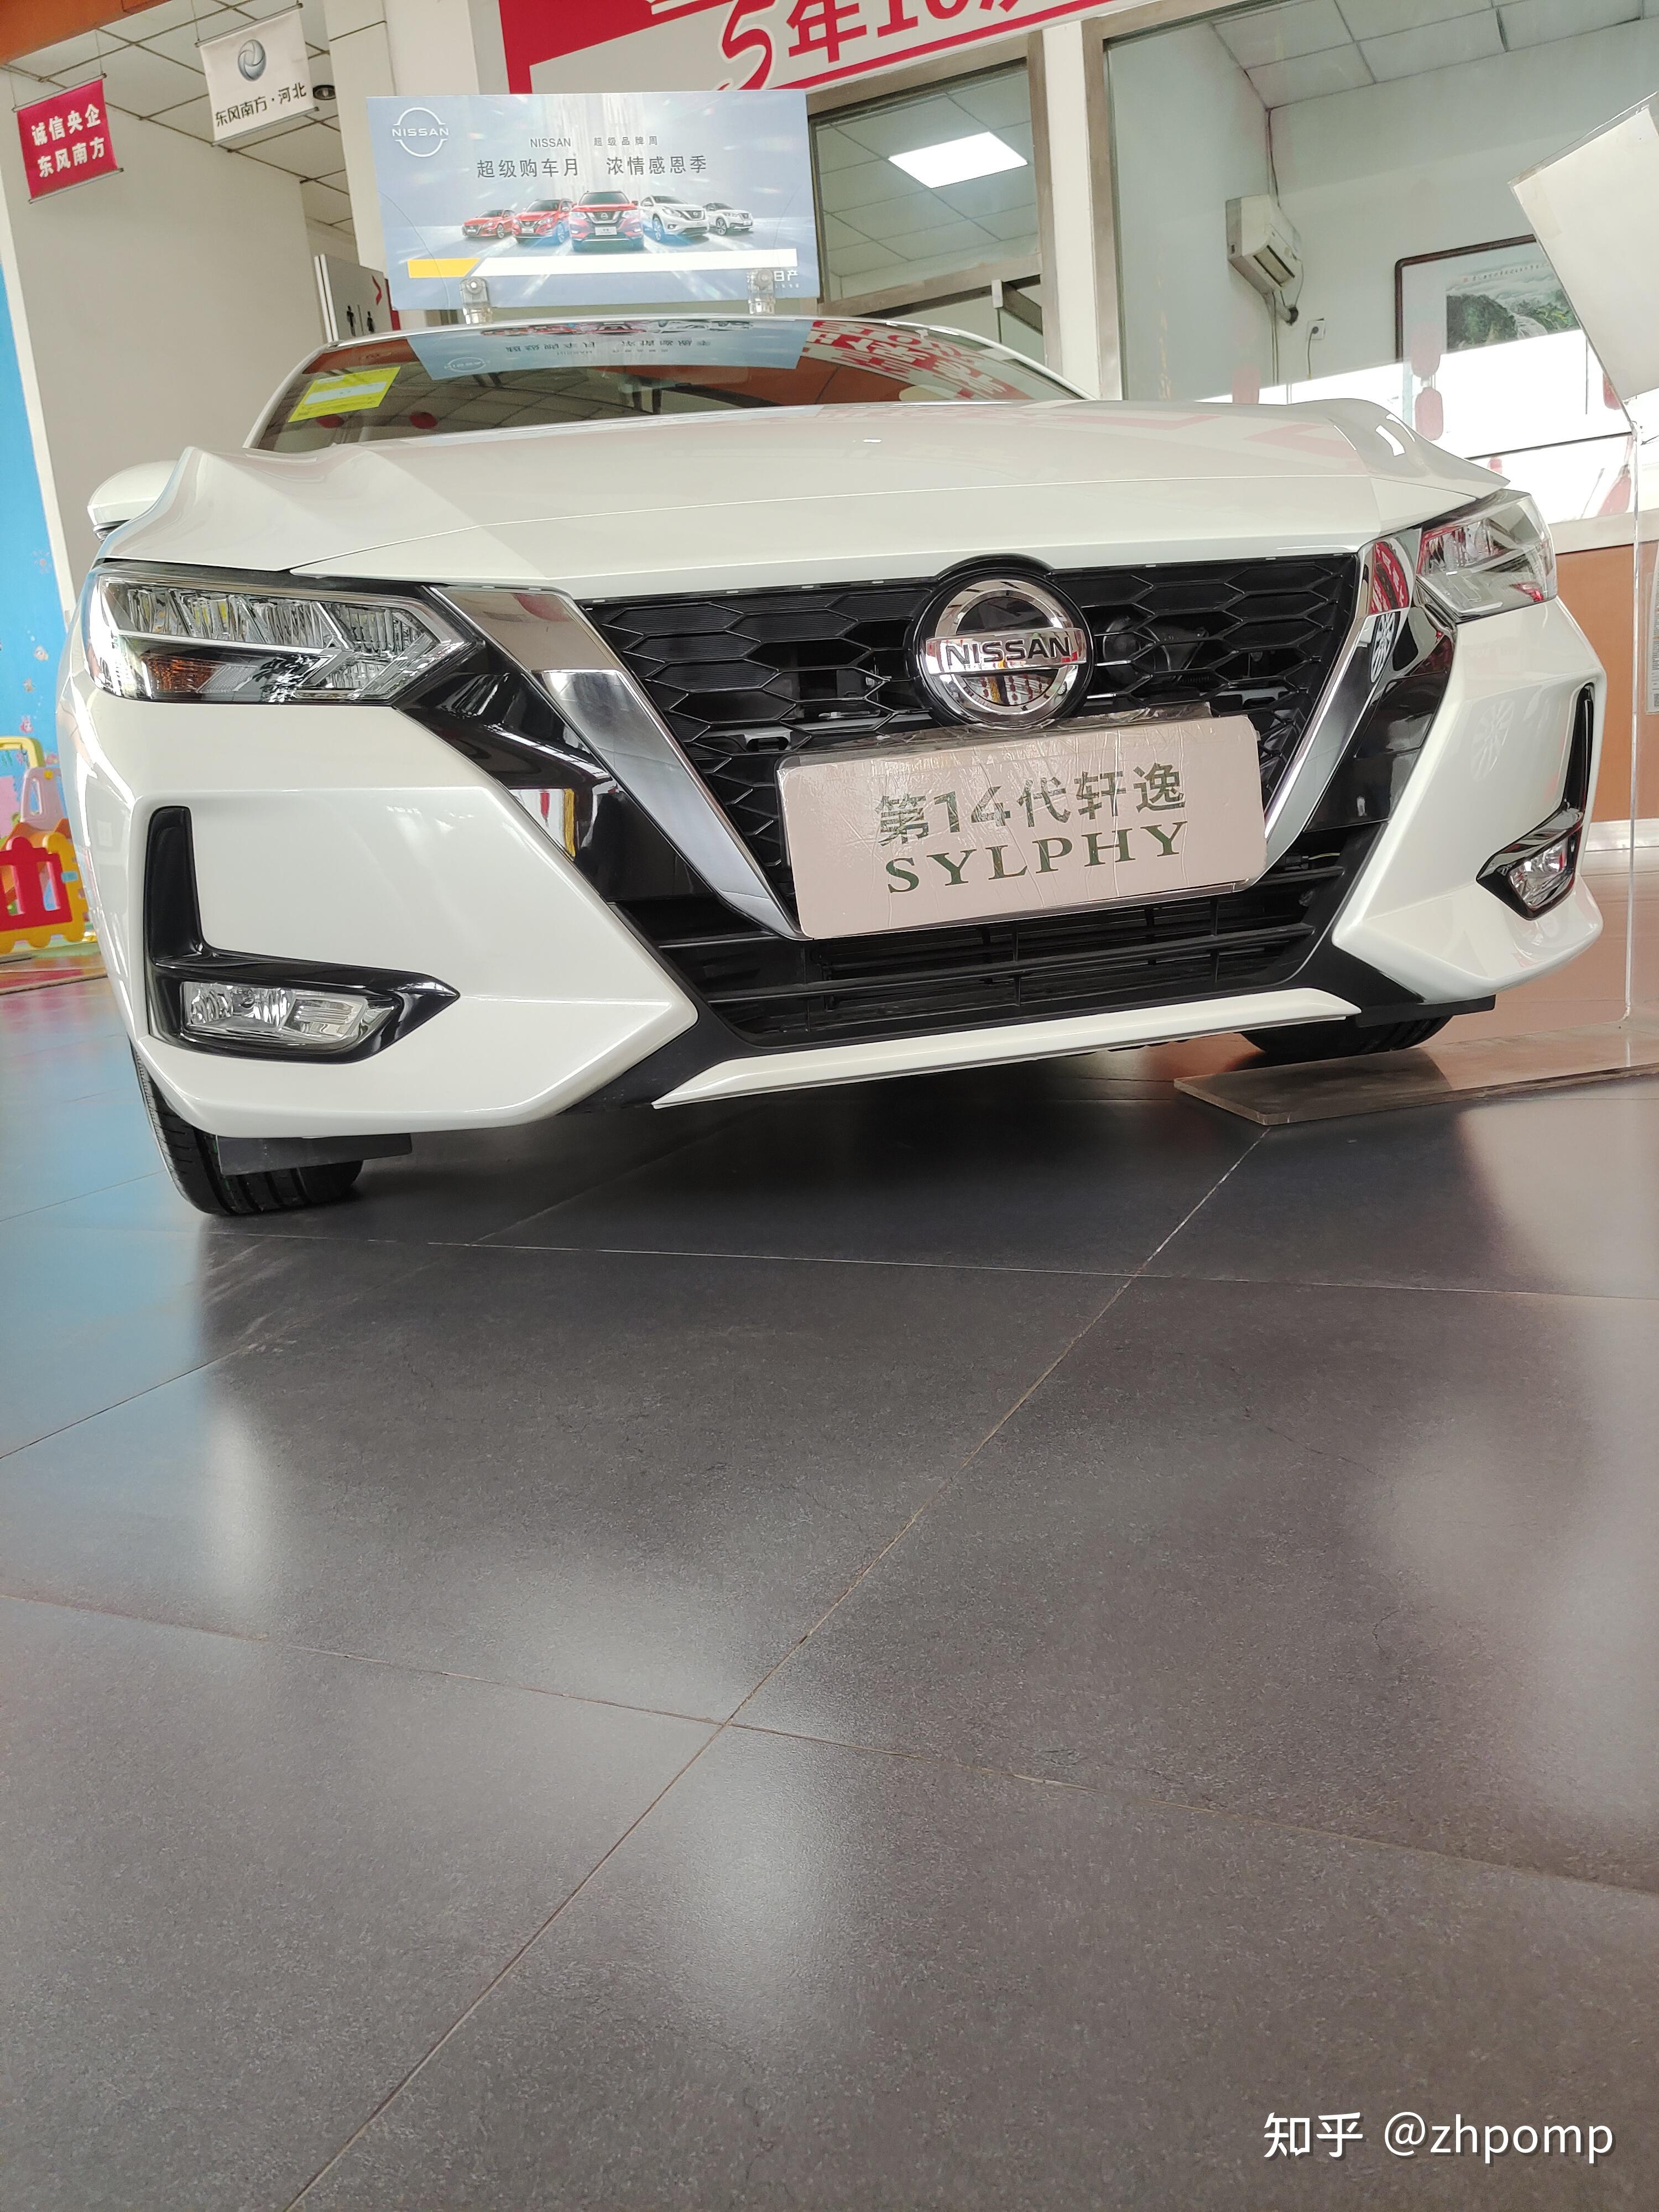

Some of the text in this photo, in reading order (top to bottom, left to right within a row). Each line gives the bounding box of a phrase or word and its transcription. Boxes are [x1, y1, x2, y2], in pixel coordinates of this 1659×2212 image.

[31, 103, 101, 146] 诚信央企
[392, 128, 449, 137] NISSAN
[530, 136, 658, 148] NISSAN 超级品牌周
[37, 137, 105, 178] 东风南方
[477, 155, 707, 178] 超级购车月 浓情感恩季
[946, 637, 1072, 666] NISSAN
[875, 762, 1185, 846] 第14代轩逸
[885, 821, 1188, 894] SYLPHY
